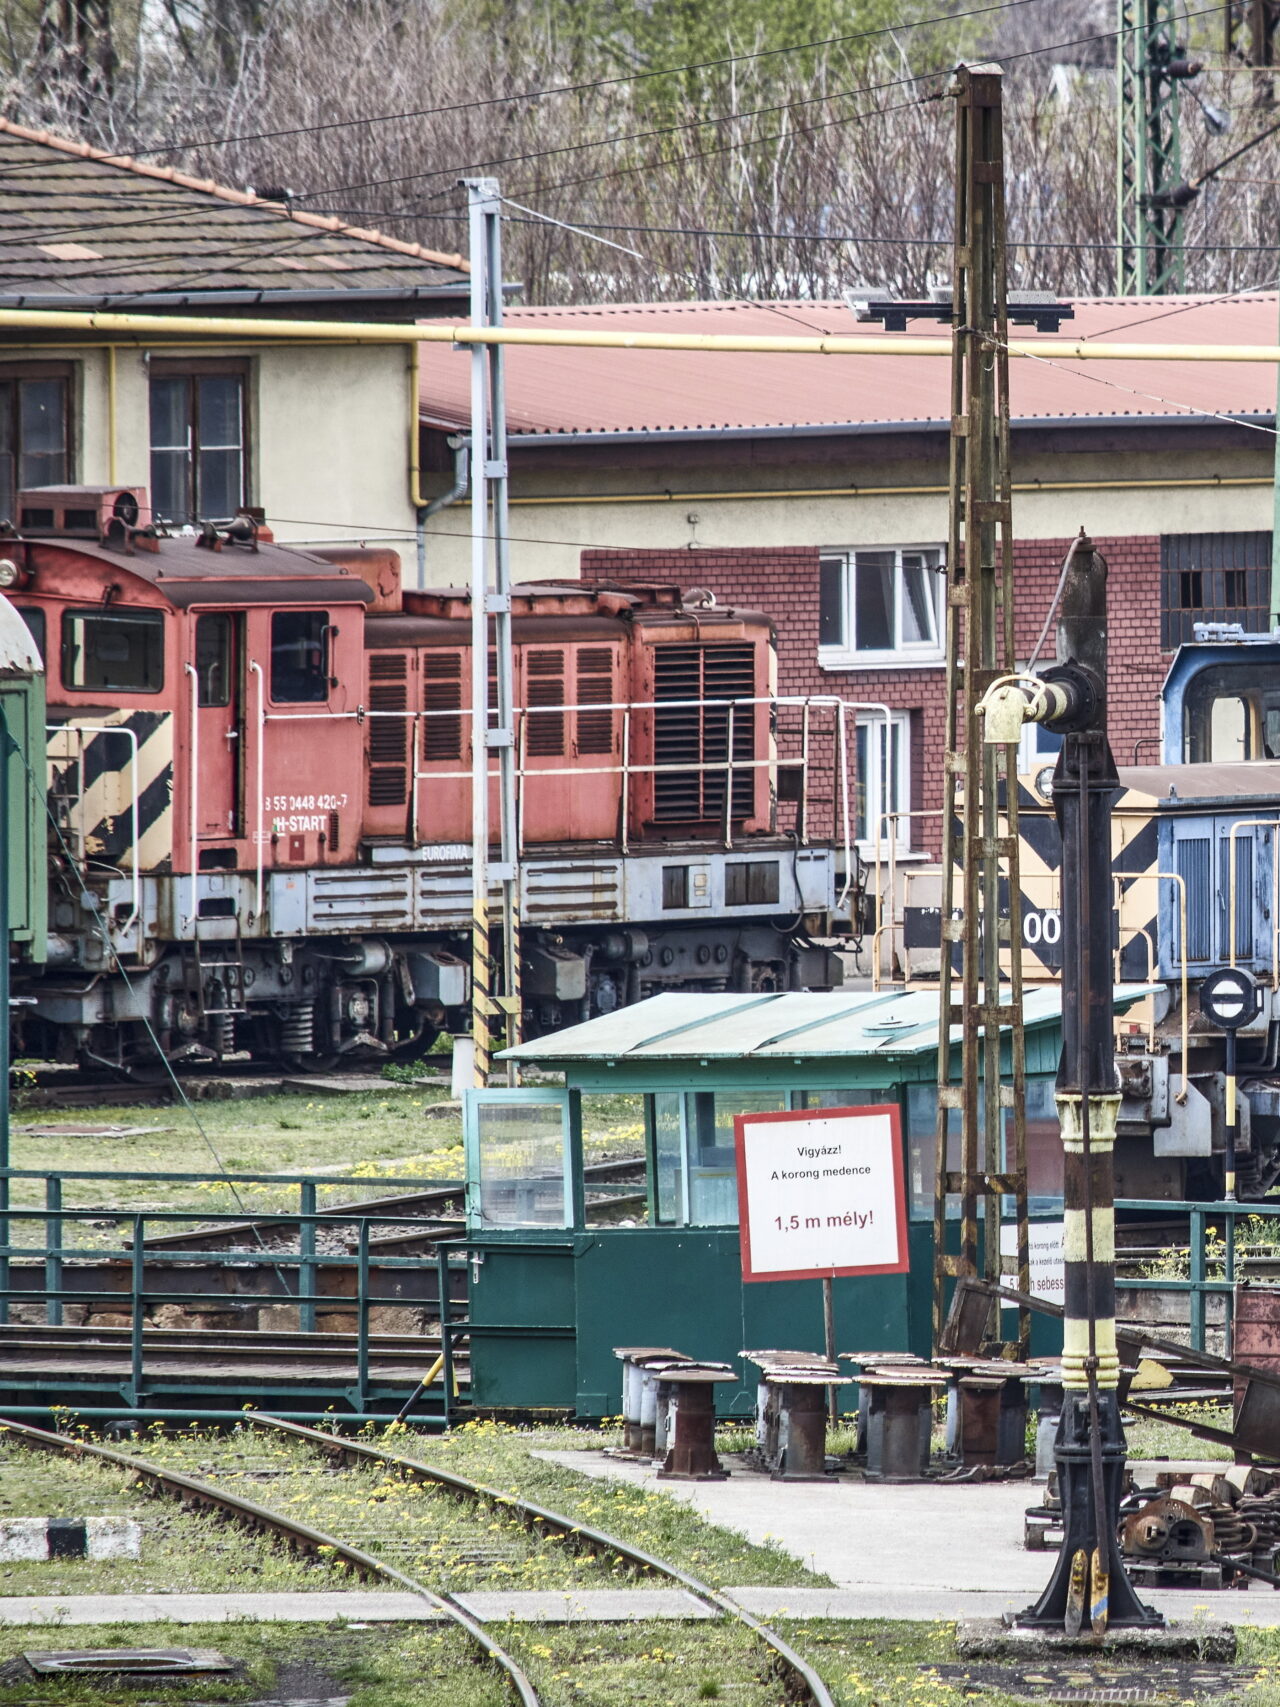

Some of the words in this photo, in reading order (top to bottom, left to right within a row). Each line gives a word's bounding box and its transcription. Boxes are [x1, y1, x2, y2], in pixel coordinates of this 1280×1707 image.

[273, 795, 287, 811] 55
[317, 793, 348, 810] 420-7
[276, 815, 327, 832] H-START
[422, 844, 468, 861] EUROFIMA
[797, 1144, 842, 1158] Vigyázz!
[771, 1171, 779, 1181] A
[781, 1168, 820, 1180] korong
[822, 1165, 871, 1177] medence
[774, 1215, 800, 1233] 1,5
[805, 1217, 821, 1229] m
[826, 1210, 874, 1229] mély!
